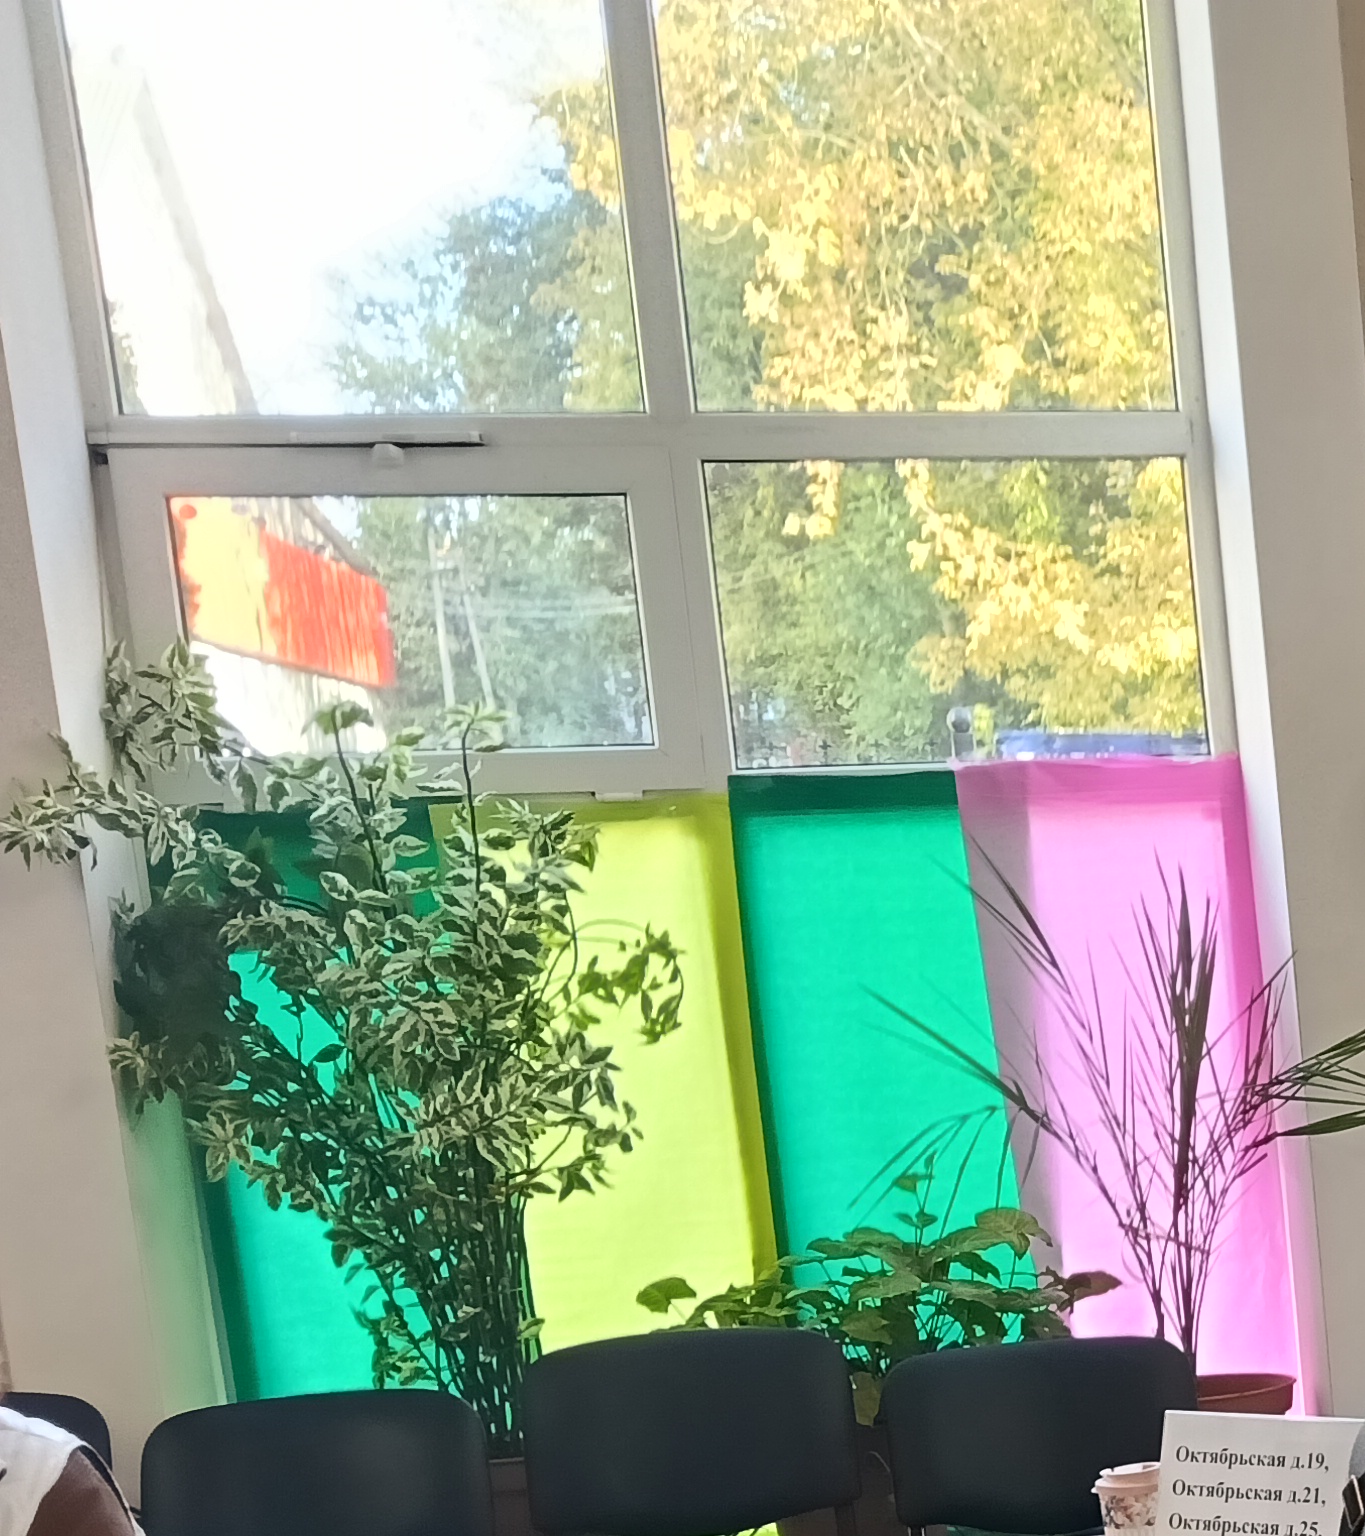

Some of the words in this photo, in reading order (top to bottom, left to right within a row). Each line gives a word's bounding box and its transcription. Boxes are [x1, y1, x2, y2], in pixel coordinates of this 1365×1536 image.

[1176, 1445, 1286, 1470] Октябрьская
[1290, 1453, 1329, 1473] д.19,
[1172, 1479, 1282, 1503] Октябрьская
[1287, 1486, 1326, 1508] д.21,
[1168, 1512, 1279, 1536] Октябрьская
